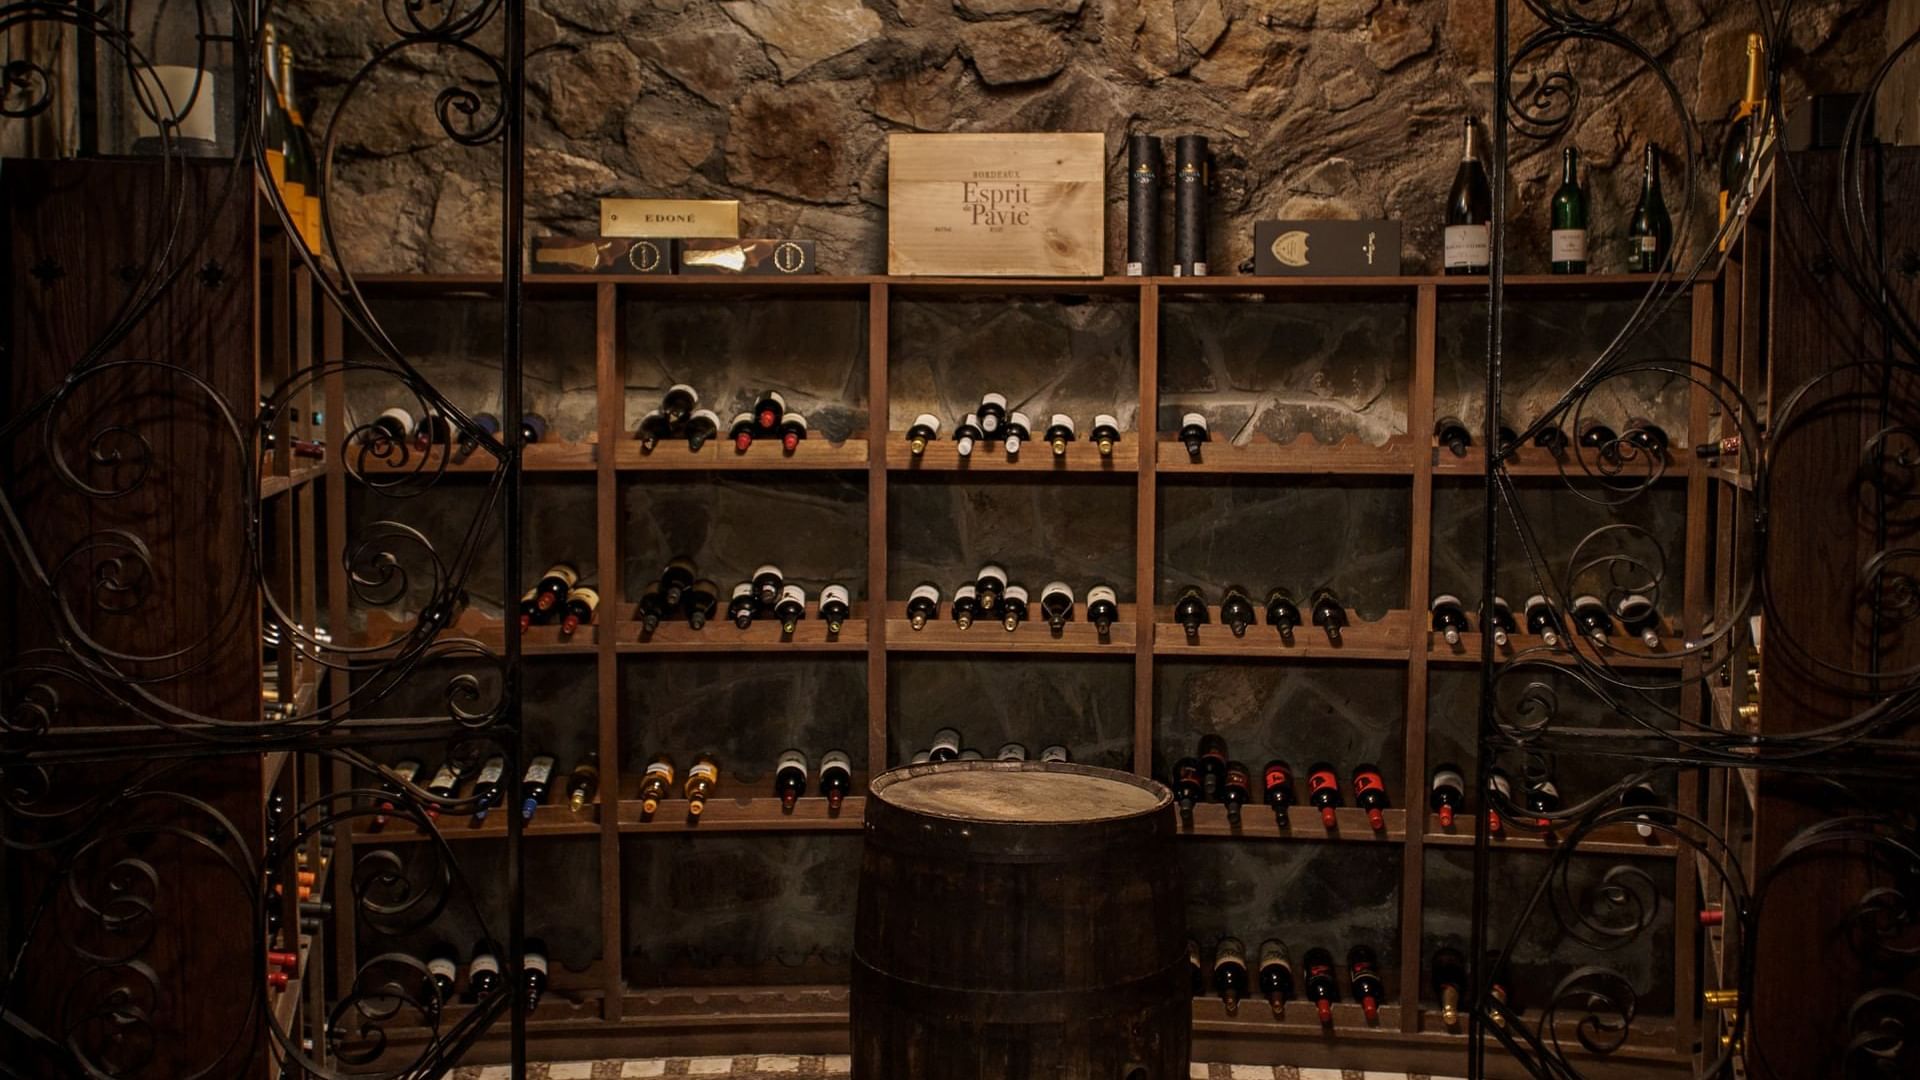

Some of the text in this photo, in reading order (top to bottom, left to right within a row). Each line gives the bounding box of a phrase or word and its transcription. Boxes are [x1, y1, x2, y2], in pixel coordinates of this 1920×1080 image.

[962, 181, 1031, 210] Esprit
[645, 213, 695, 222] EDONÉ
[971, 204, 1030, 225] Pavie
